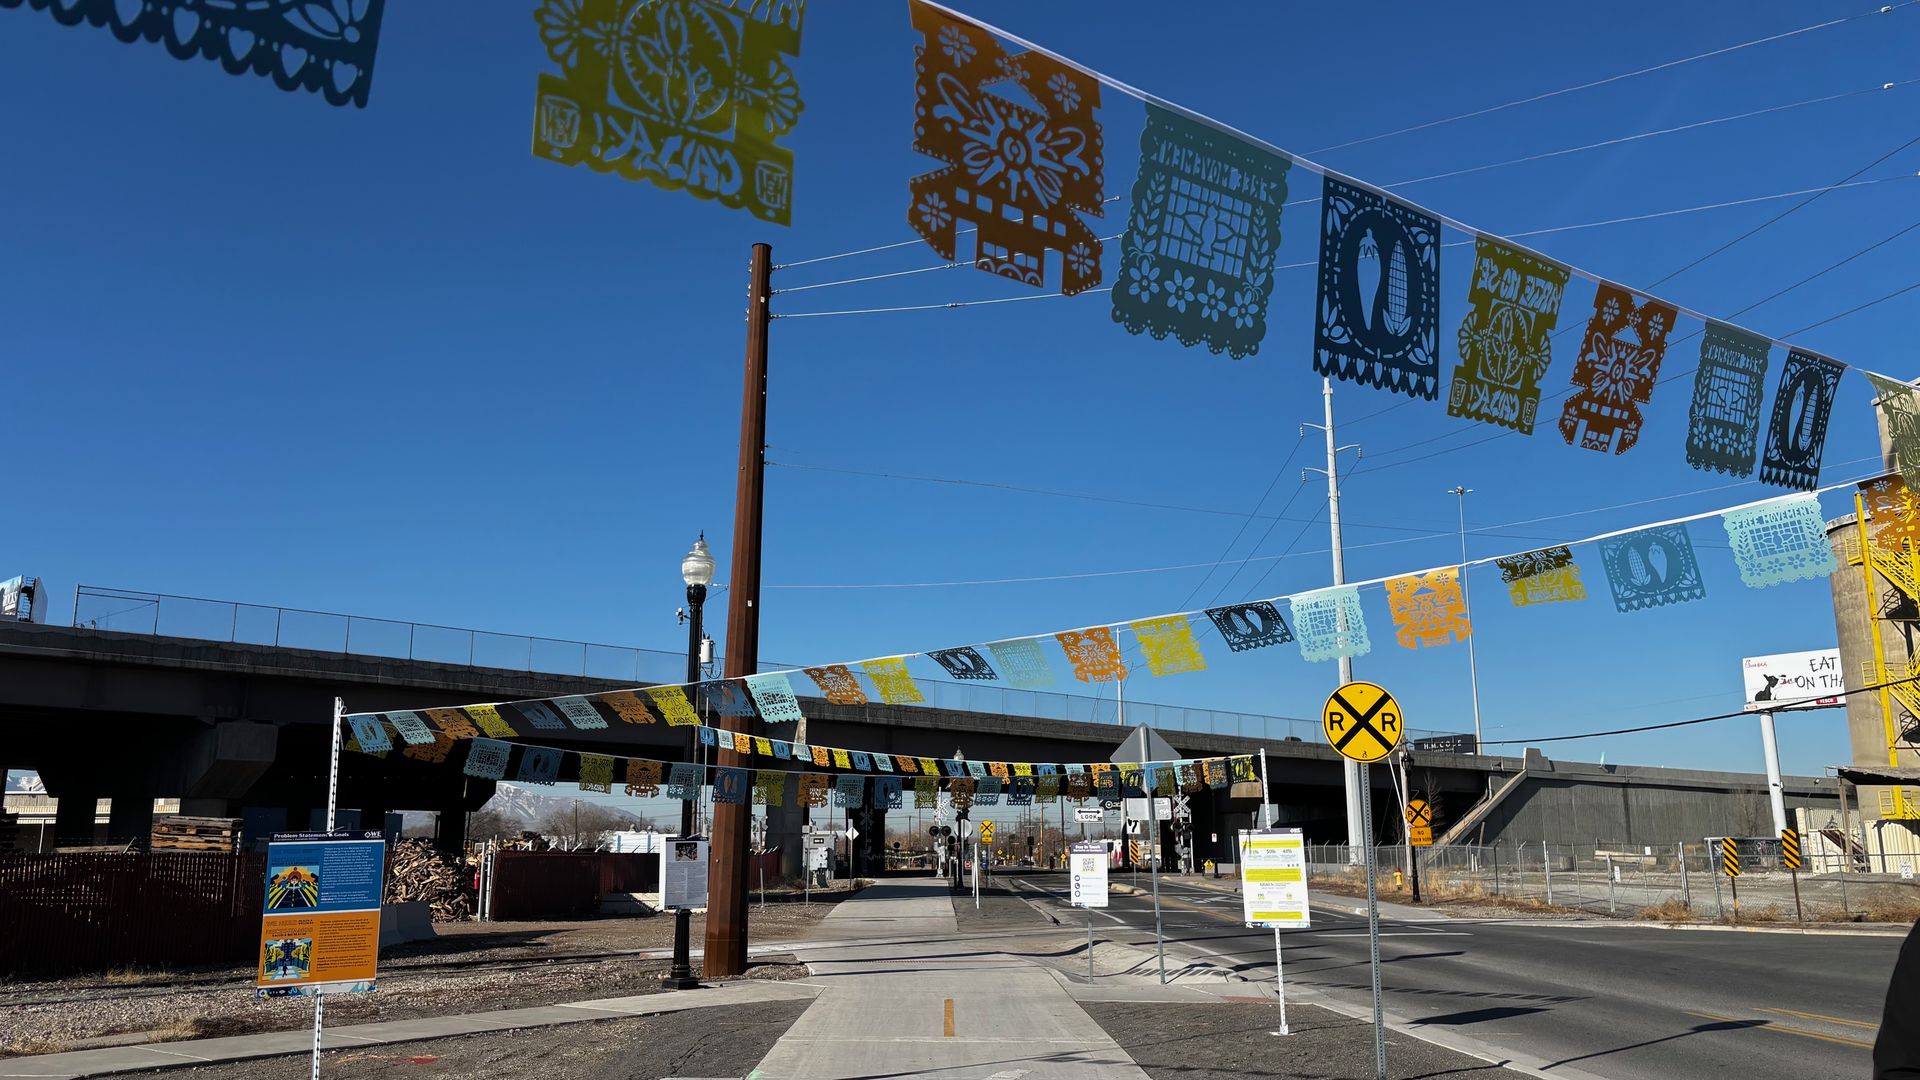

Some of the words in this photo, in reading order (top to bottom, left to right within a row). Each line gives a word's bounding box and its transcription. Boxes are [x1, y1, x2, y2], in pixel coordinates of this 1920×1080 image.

[1809, 656, 1838, 672] EAT
[1797, 675, 1815, 690] ON
[1329, 712, 1344, 731] R
[1381, 713, 1396, 732] R
